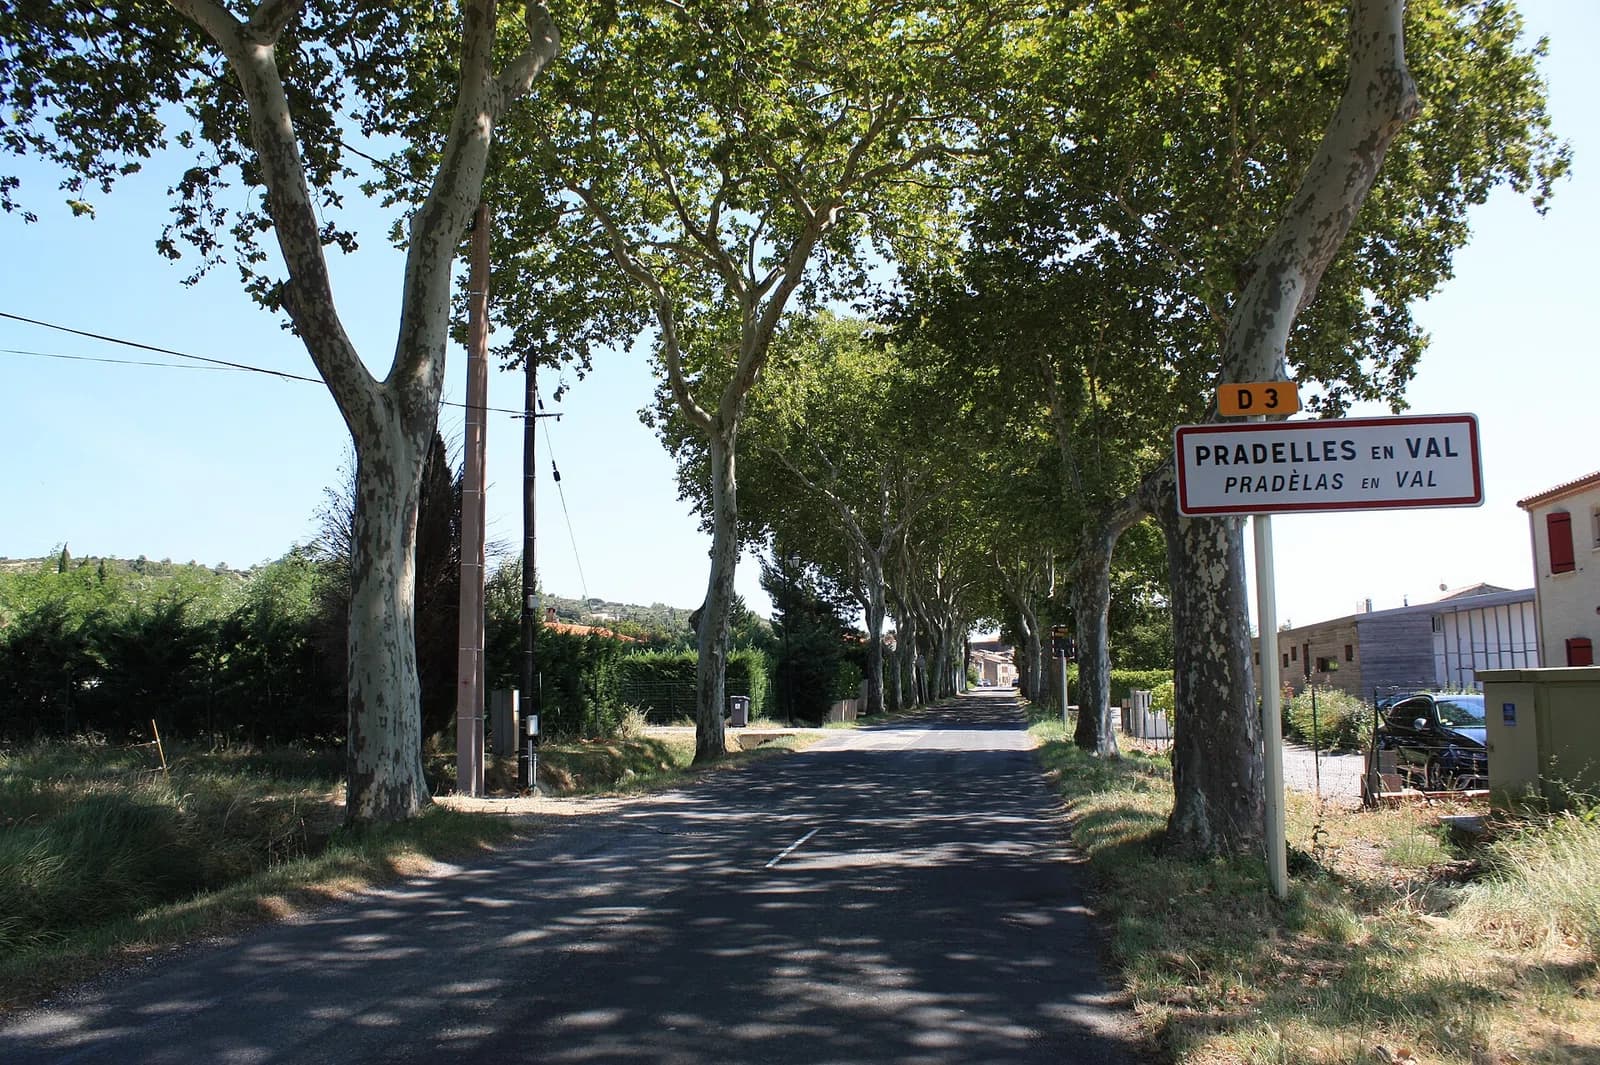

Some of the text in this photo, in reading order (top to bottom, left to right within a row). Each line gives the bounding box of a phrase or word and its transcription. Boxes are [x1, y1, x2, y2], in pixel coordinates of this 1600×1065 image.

[1238, 388, 1279, 410] D 3
[1195, 436, 1458, 466] PRADELLES EN VAL
[1225, 469, 1438, 493] PRADÈLAS EN VAL
